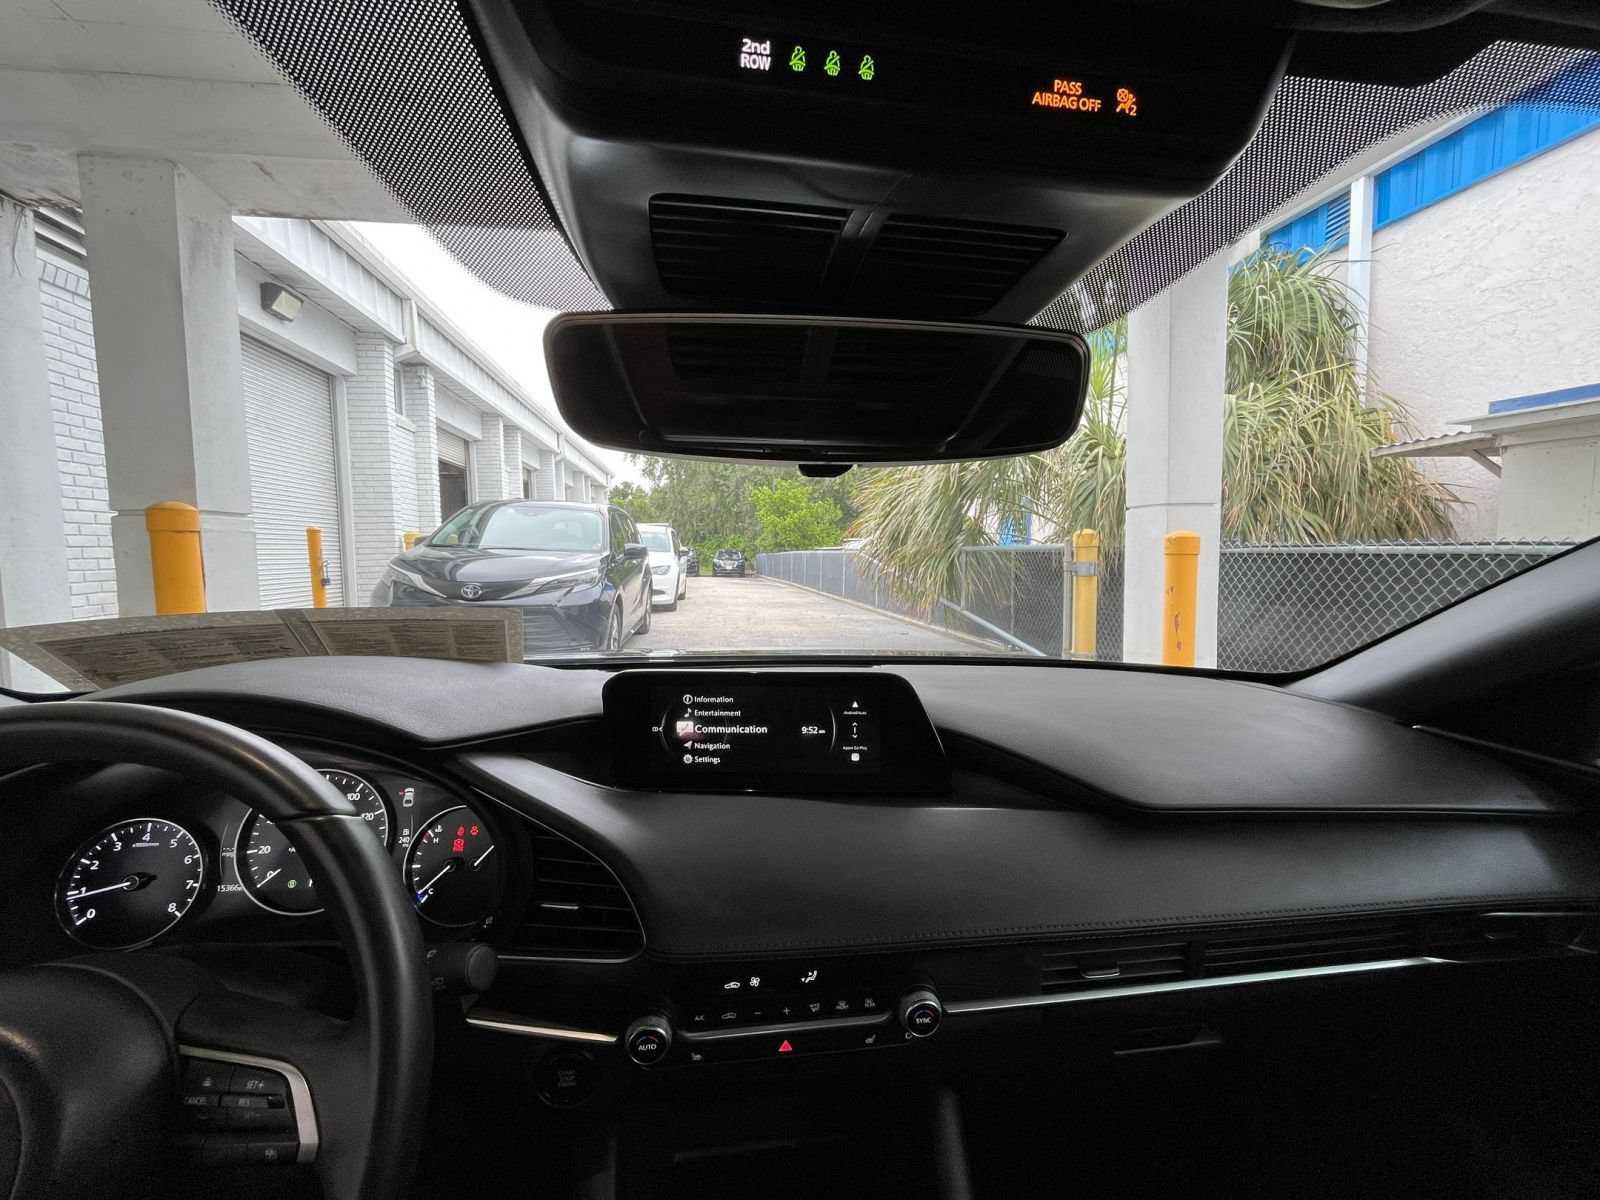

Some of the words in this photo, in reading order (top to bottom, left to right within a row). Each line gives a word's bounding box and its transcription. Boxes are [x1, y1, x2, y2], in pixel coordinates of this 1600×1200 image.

[742, 38, 770, 54] 2nd
[740, 53, 771, 71] ROW
[1053, 79, 1082, 95] PASS
[1032, 92, 1078, 109] AIRBAG
[1079, 98, 1101, 112] OFF
[694, 696, 734, 704] Information
[694, 709, 741, 717] Entertainment
[694, 724, 768, 734] Communication
[801, 726, 818, 734] 9:52
[694, 742, 731, 751] Navigation
[694, 755, 721, 764] Settings
[347, 793, 361, 801] 100
[361, 812, 374, 821] 120
[142, 832, 151, 841] 4
[113, 841, 122, 851] 3
[169, 838, 178, 848] 5
[258, 845, 271, 854] 20
[184, 855, 192, 864] 6
[90, 860, 99, 870] 2
[186, 880, 193, 890] 7
[80, 886, 87, 895] 1
[428, 887, 434, 895] C
[168, 902, 177, 913] 8
[86, 908, 96, 919] 0
[638, 1043, 657, 1051] AUTO
